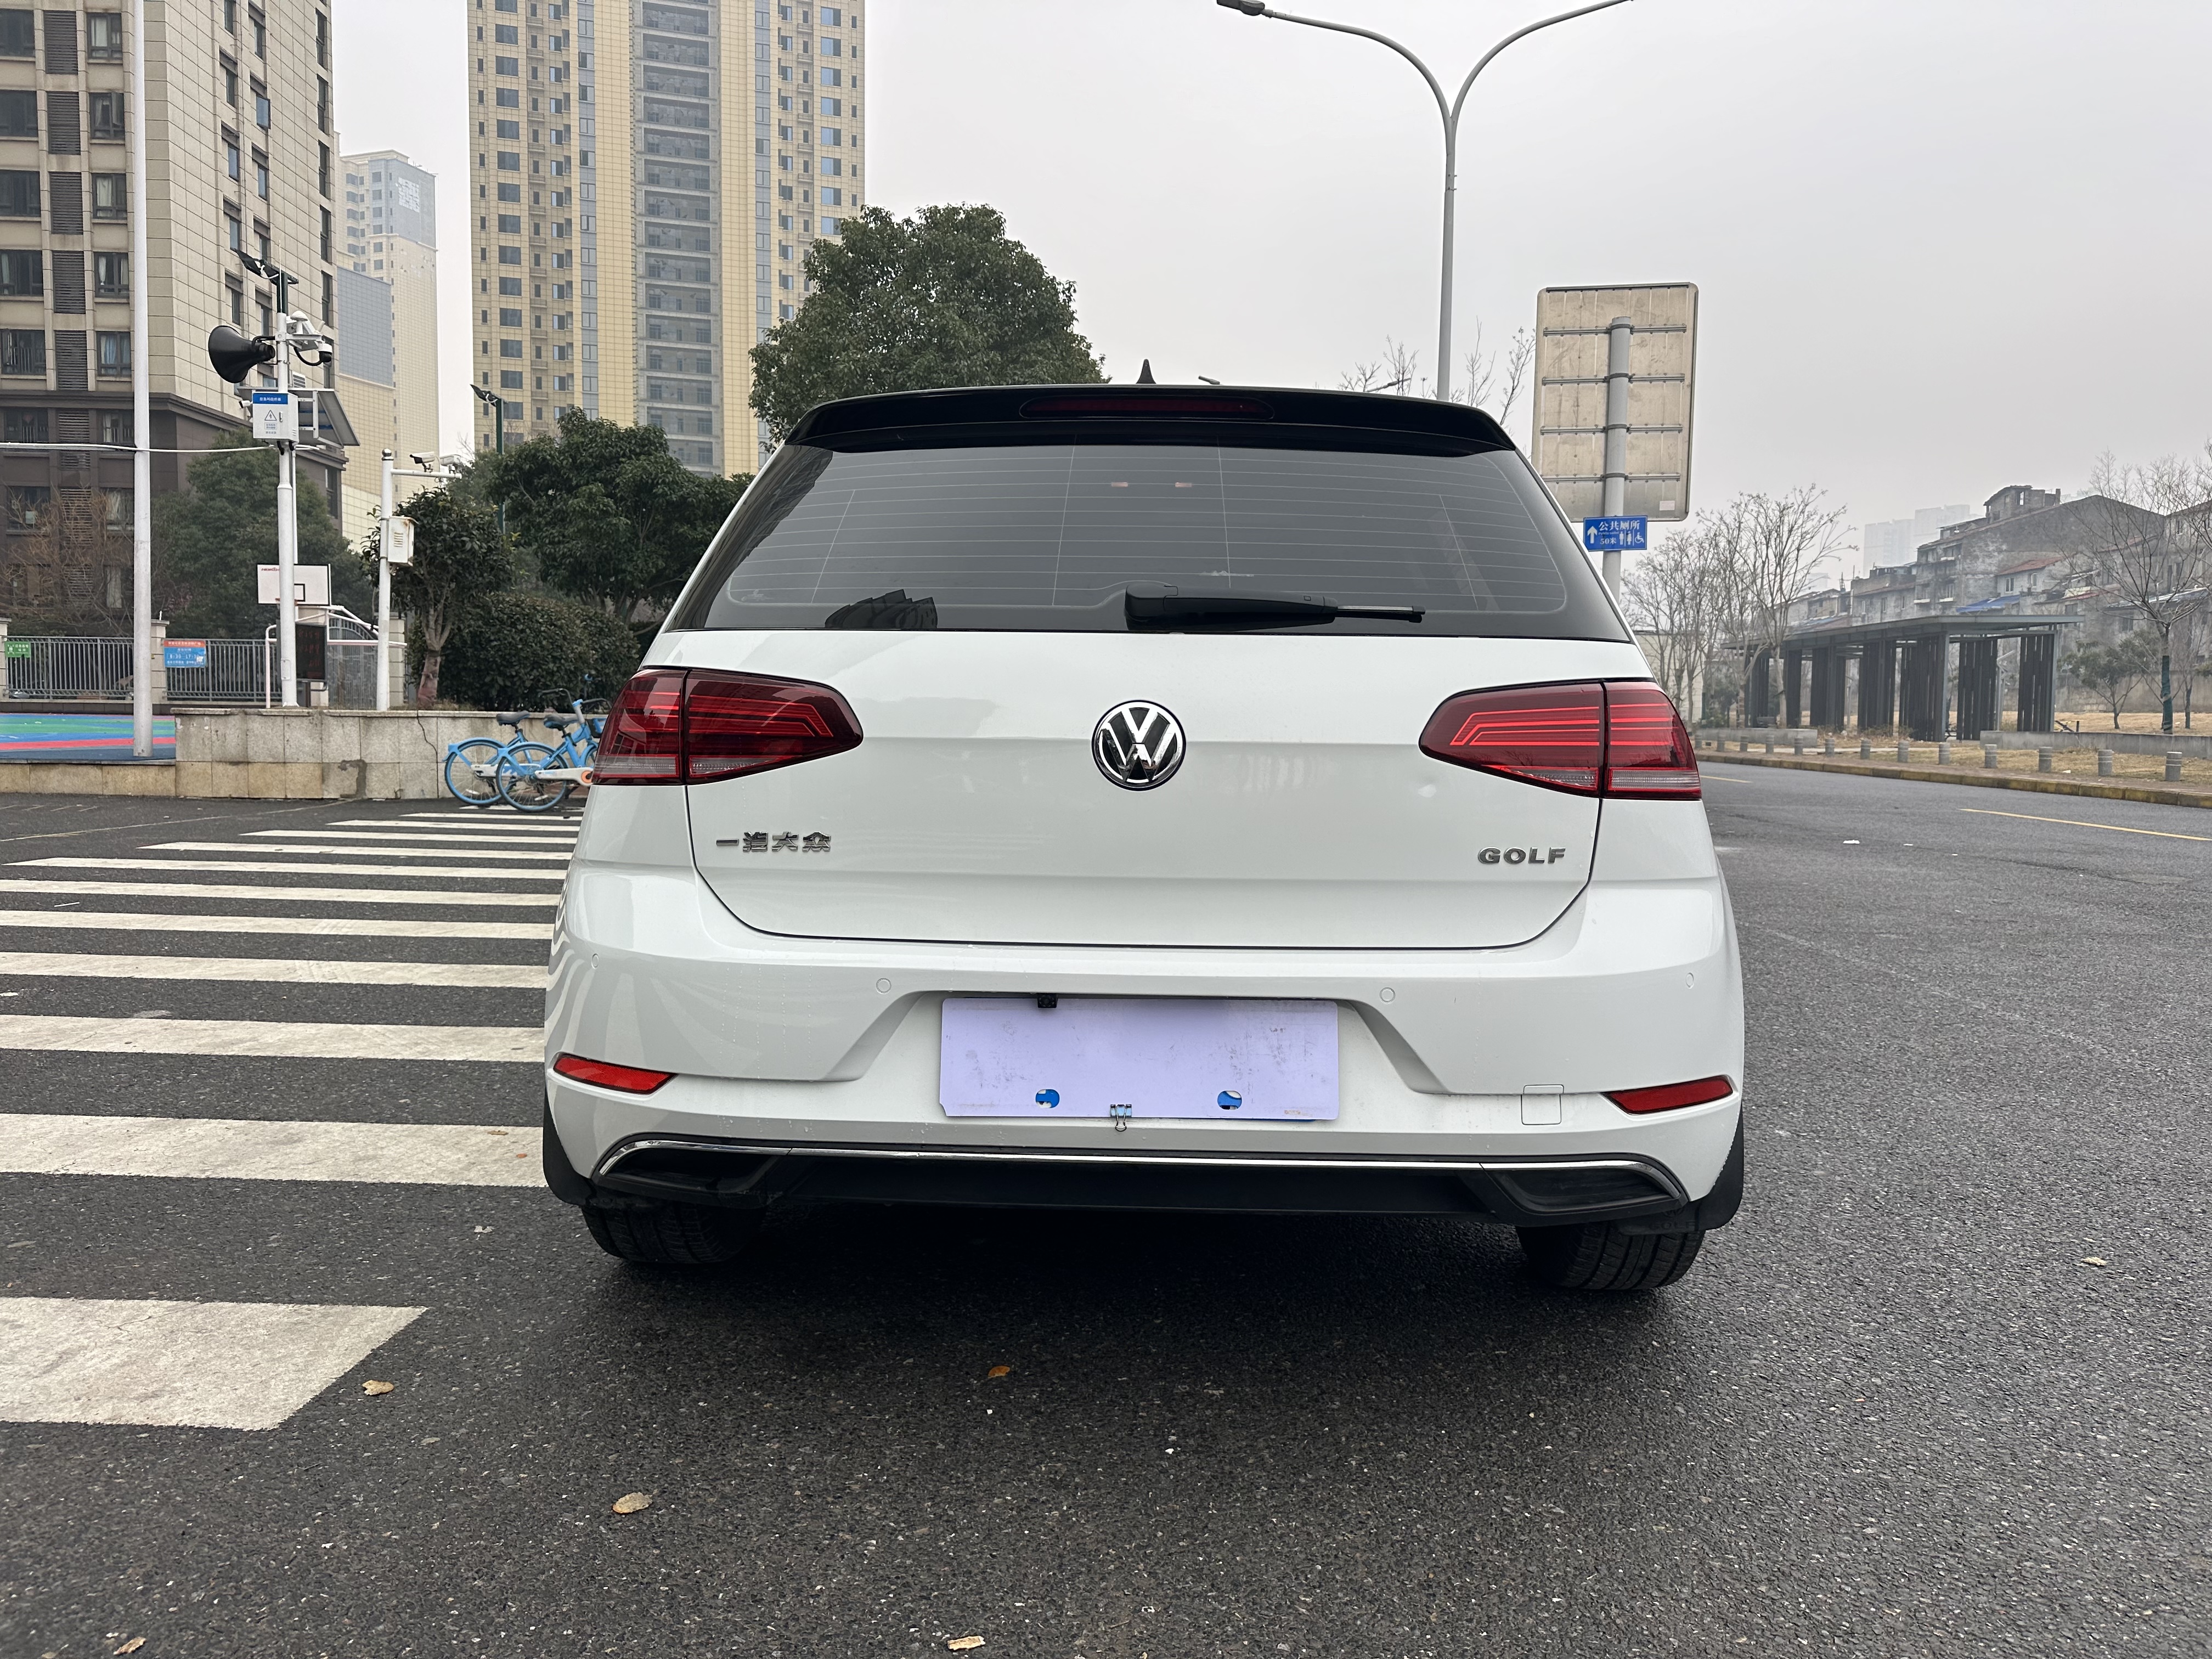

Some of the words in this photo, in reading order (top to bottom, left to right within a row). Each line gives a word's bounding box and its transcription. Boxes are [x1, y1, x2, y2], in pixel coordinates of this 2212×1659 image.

[1599, 520, 1640, 531] 公共厕所
[716, 831, 832, 853] 一汽大众
[1477, 847, 1566, 865] GOLF
